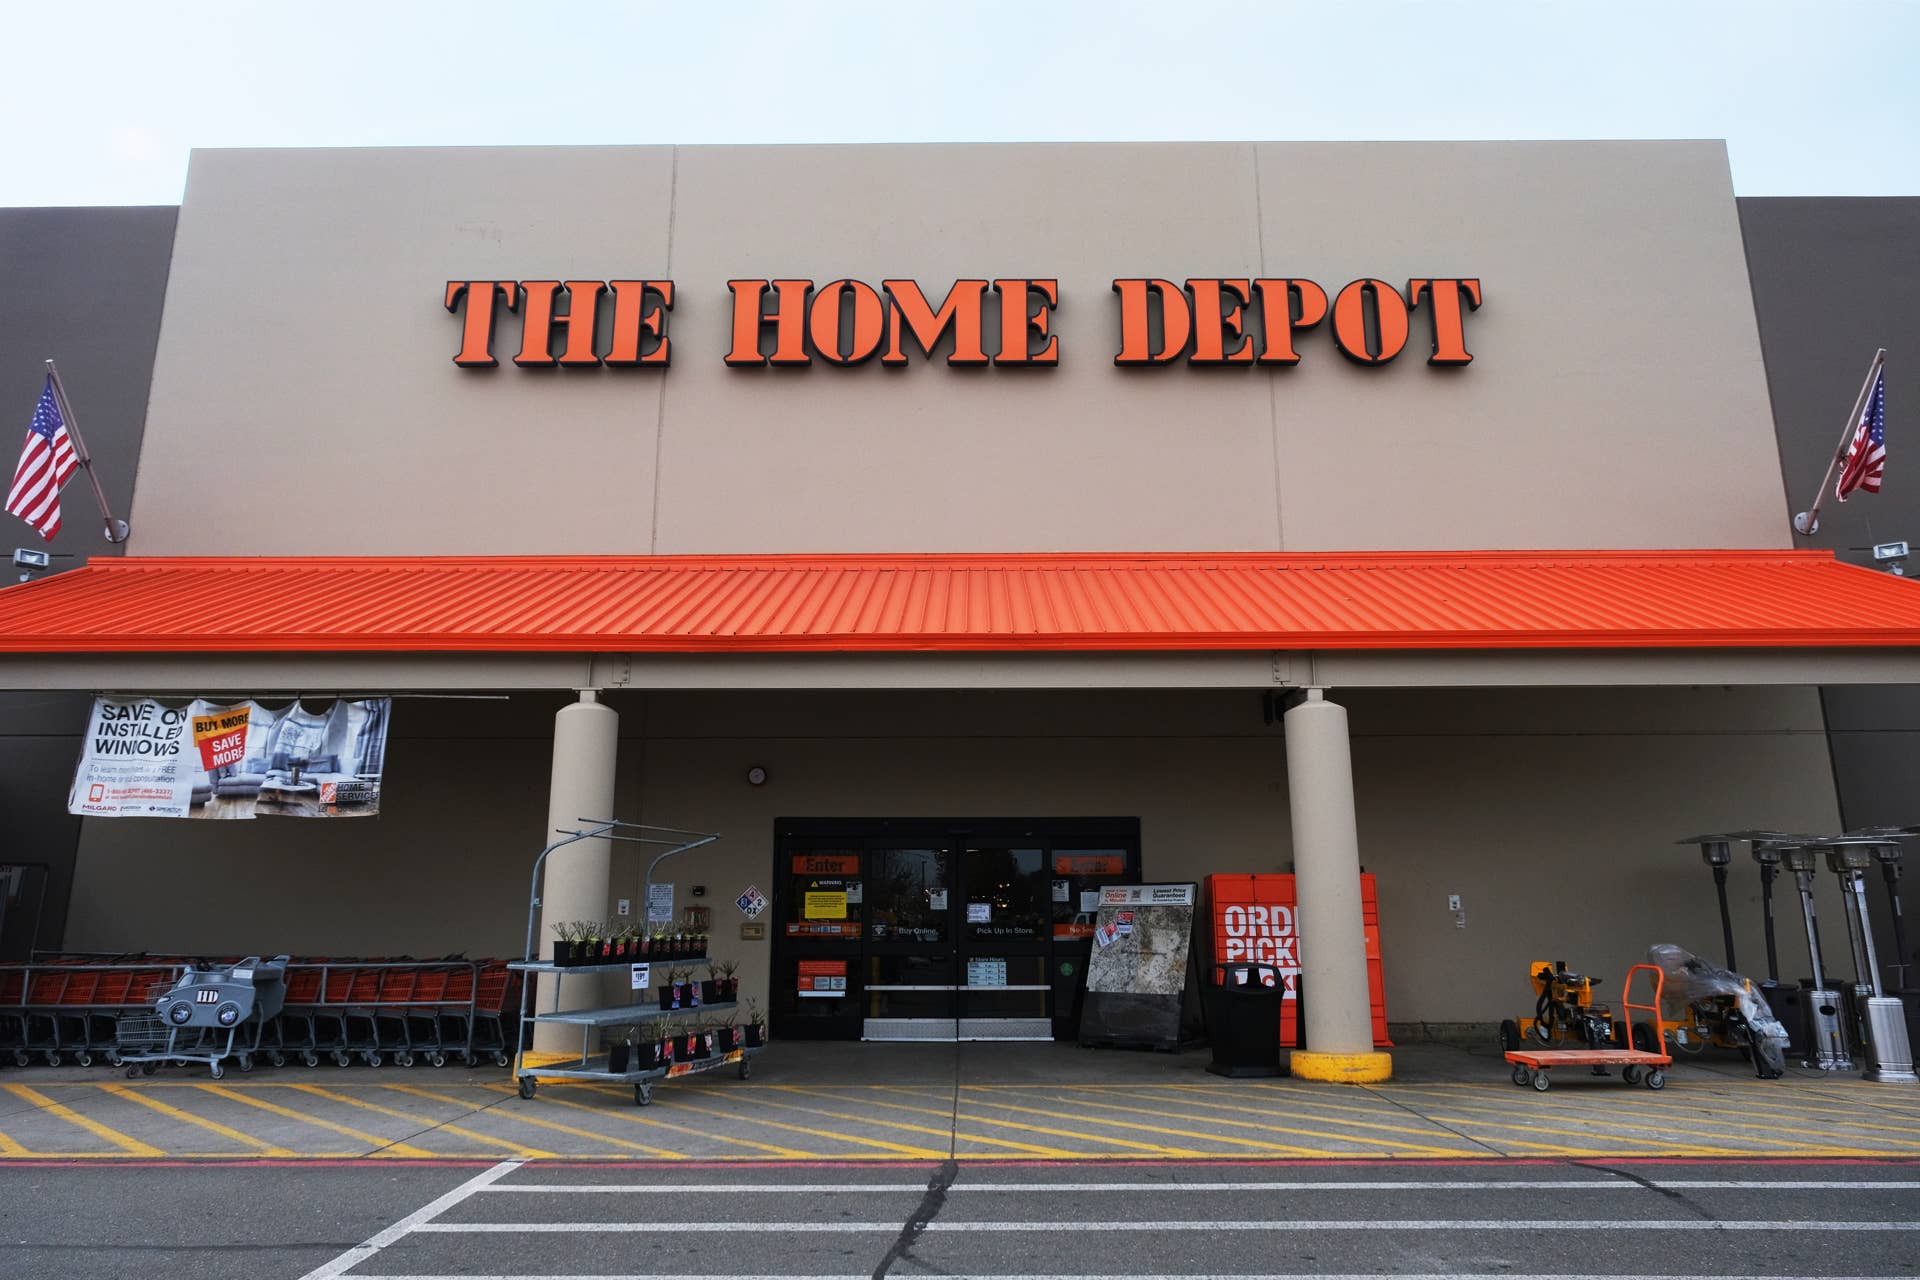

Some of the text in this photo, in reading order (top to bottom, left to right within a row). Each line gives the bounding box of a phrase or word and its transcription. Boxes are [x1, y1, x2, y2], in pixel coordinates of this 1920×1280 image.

[446, 278, 1482, 368] THE HOME DEPOT
[102, 703, 188, 726] SAVE ON
[195, 712, 249, 733] BUY MORE
[98, 722, 183, 741] INSTALLED
[211, 733, 242, 753] SAVE
[213, 746, 244, 767] MORE
[337, 783, 364, 791] HOME
[806, 858, 846, 873] Enter
[993, 927, 1005, 935] Up
[1226, 937, 1302, 967] PICK
[196, 990, 219, 1003] HD
